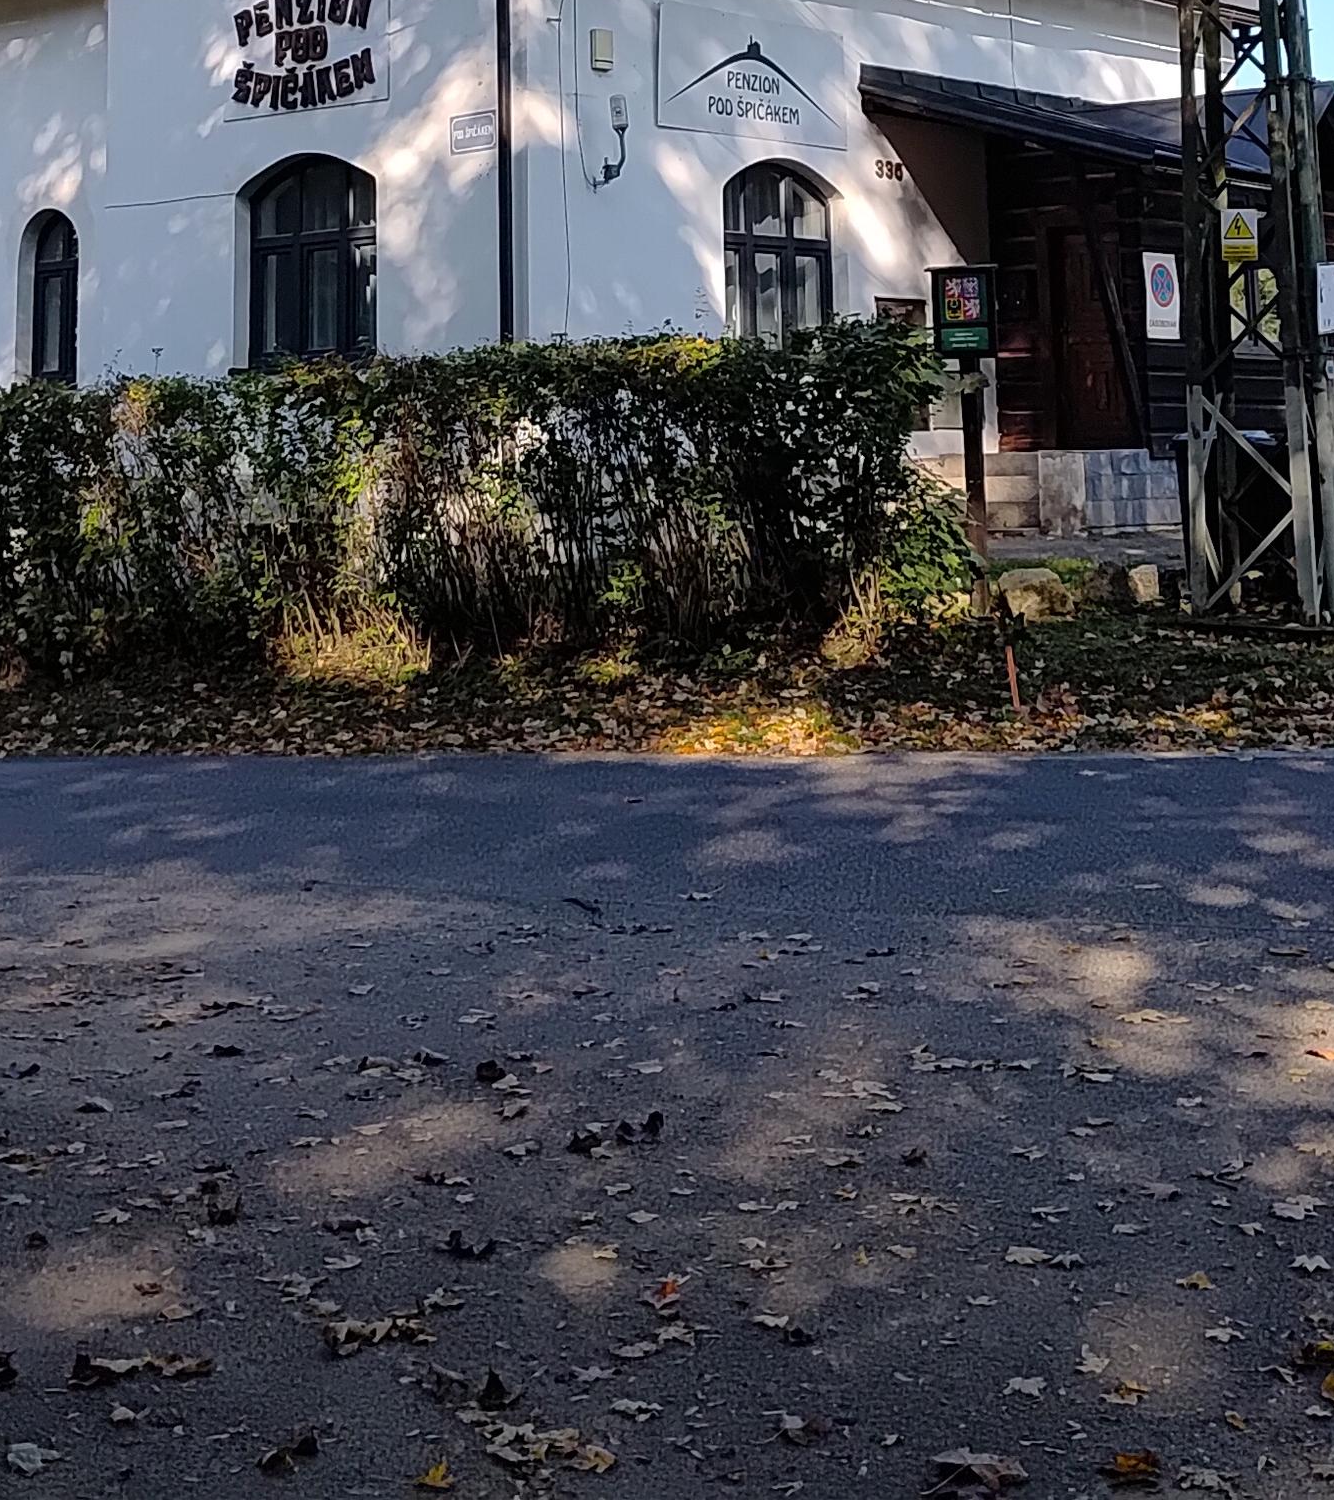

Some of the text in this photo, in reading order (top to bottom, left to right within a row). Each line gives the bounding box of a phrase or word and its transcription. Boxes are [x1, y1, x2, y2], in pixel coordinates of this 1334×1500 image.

[275, 25, 328, 67] POD
[231, 48, 376, 111] ŠPIČÁKEM
[727, 70, 780, 95] PENZION
[708, 95, 800, 125] POD ŠPIČÁKEM
